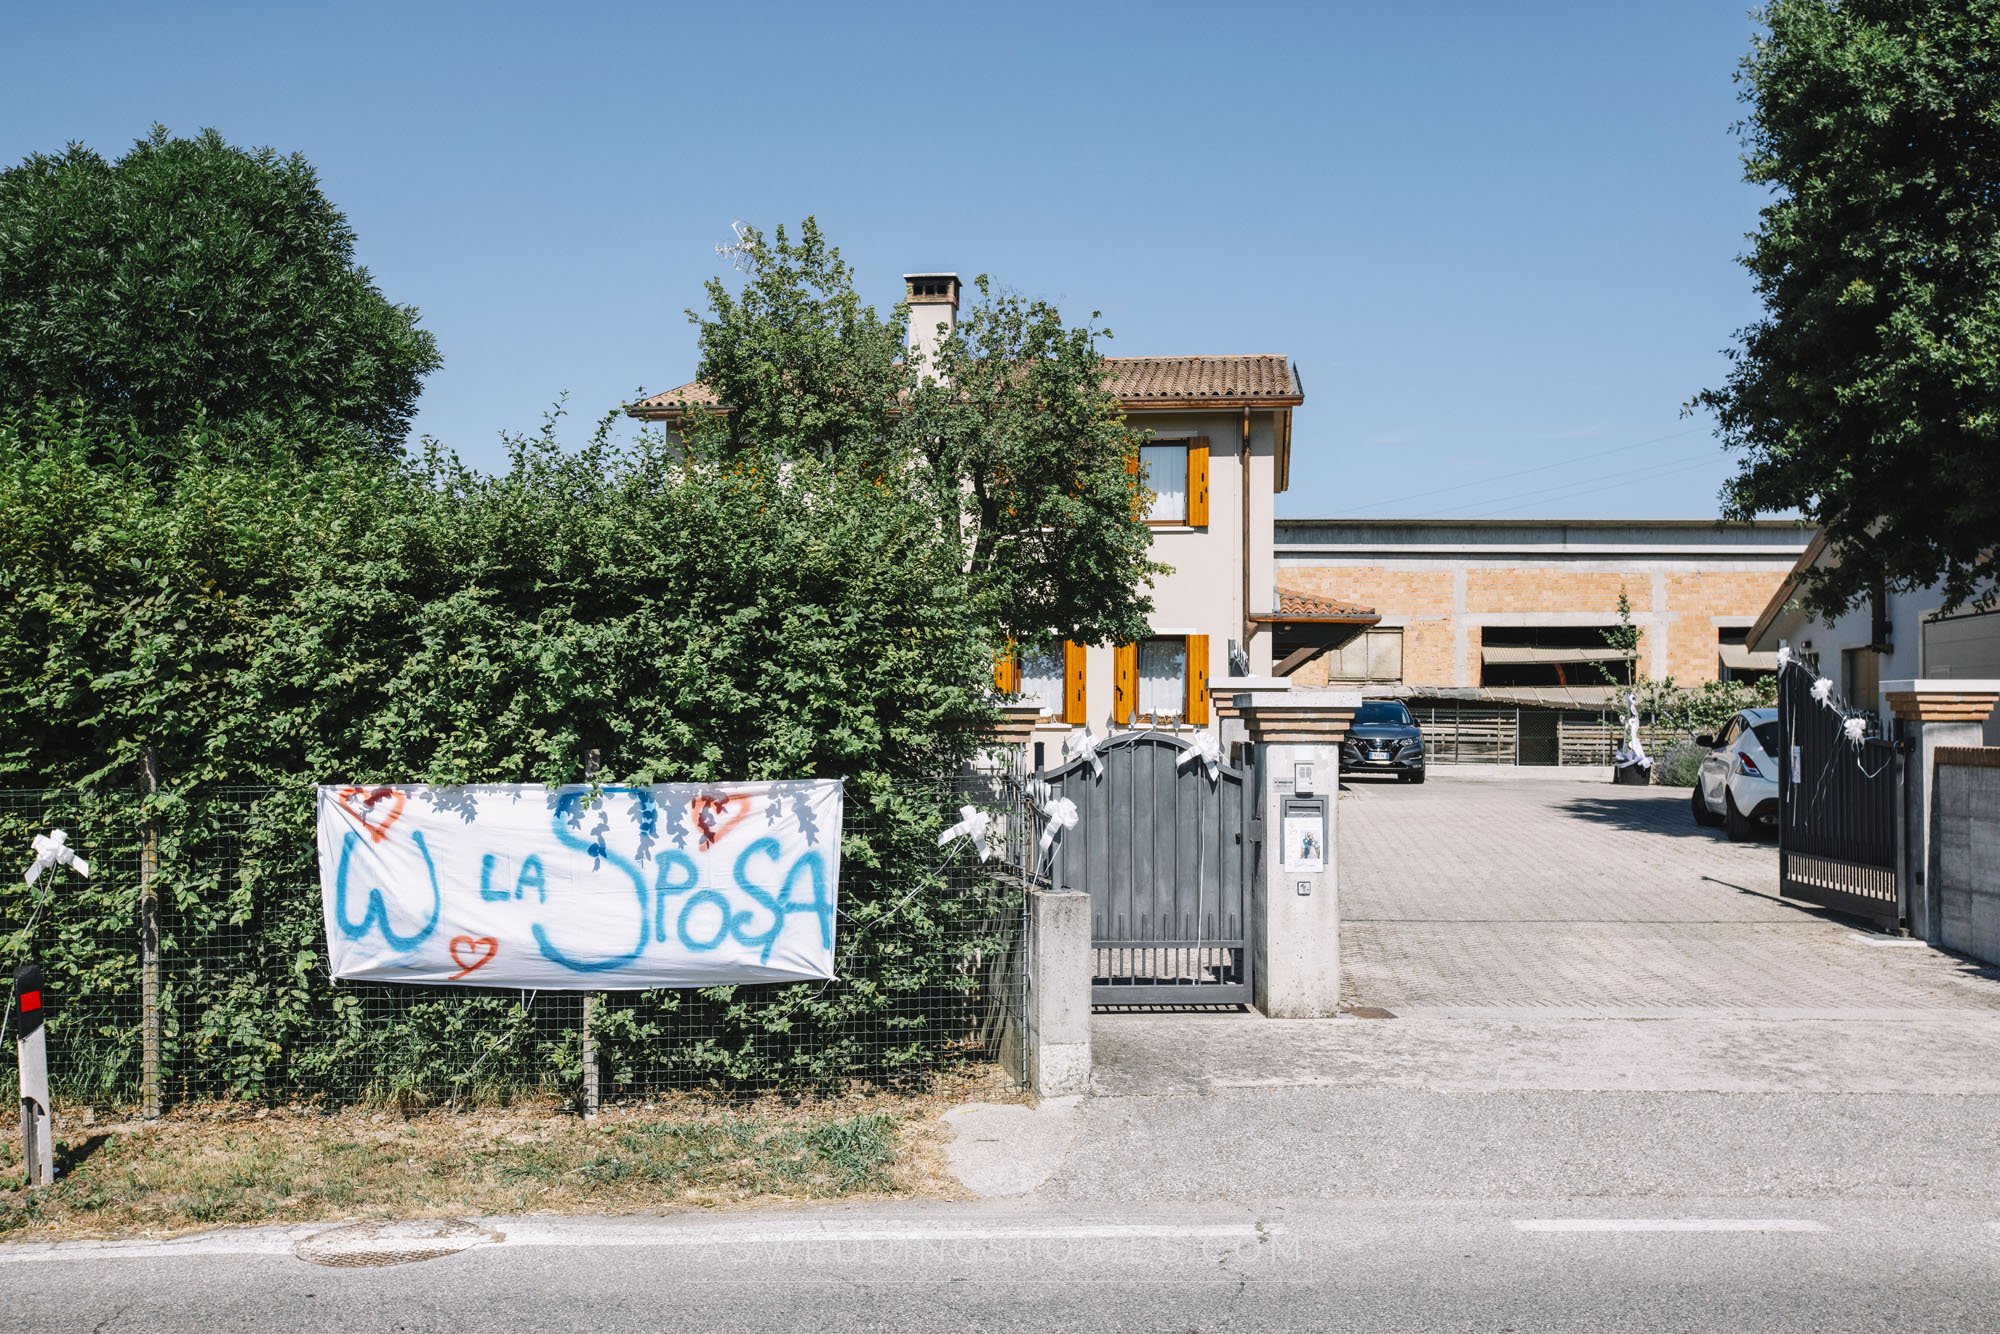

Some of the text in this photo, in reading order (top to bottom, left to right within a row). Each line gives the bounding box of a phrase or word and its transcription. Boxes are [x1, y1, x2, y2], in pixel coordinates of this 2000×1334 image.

[336, 786, 832, 972] W LA SPOSA
